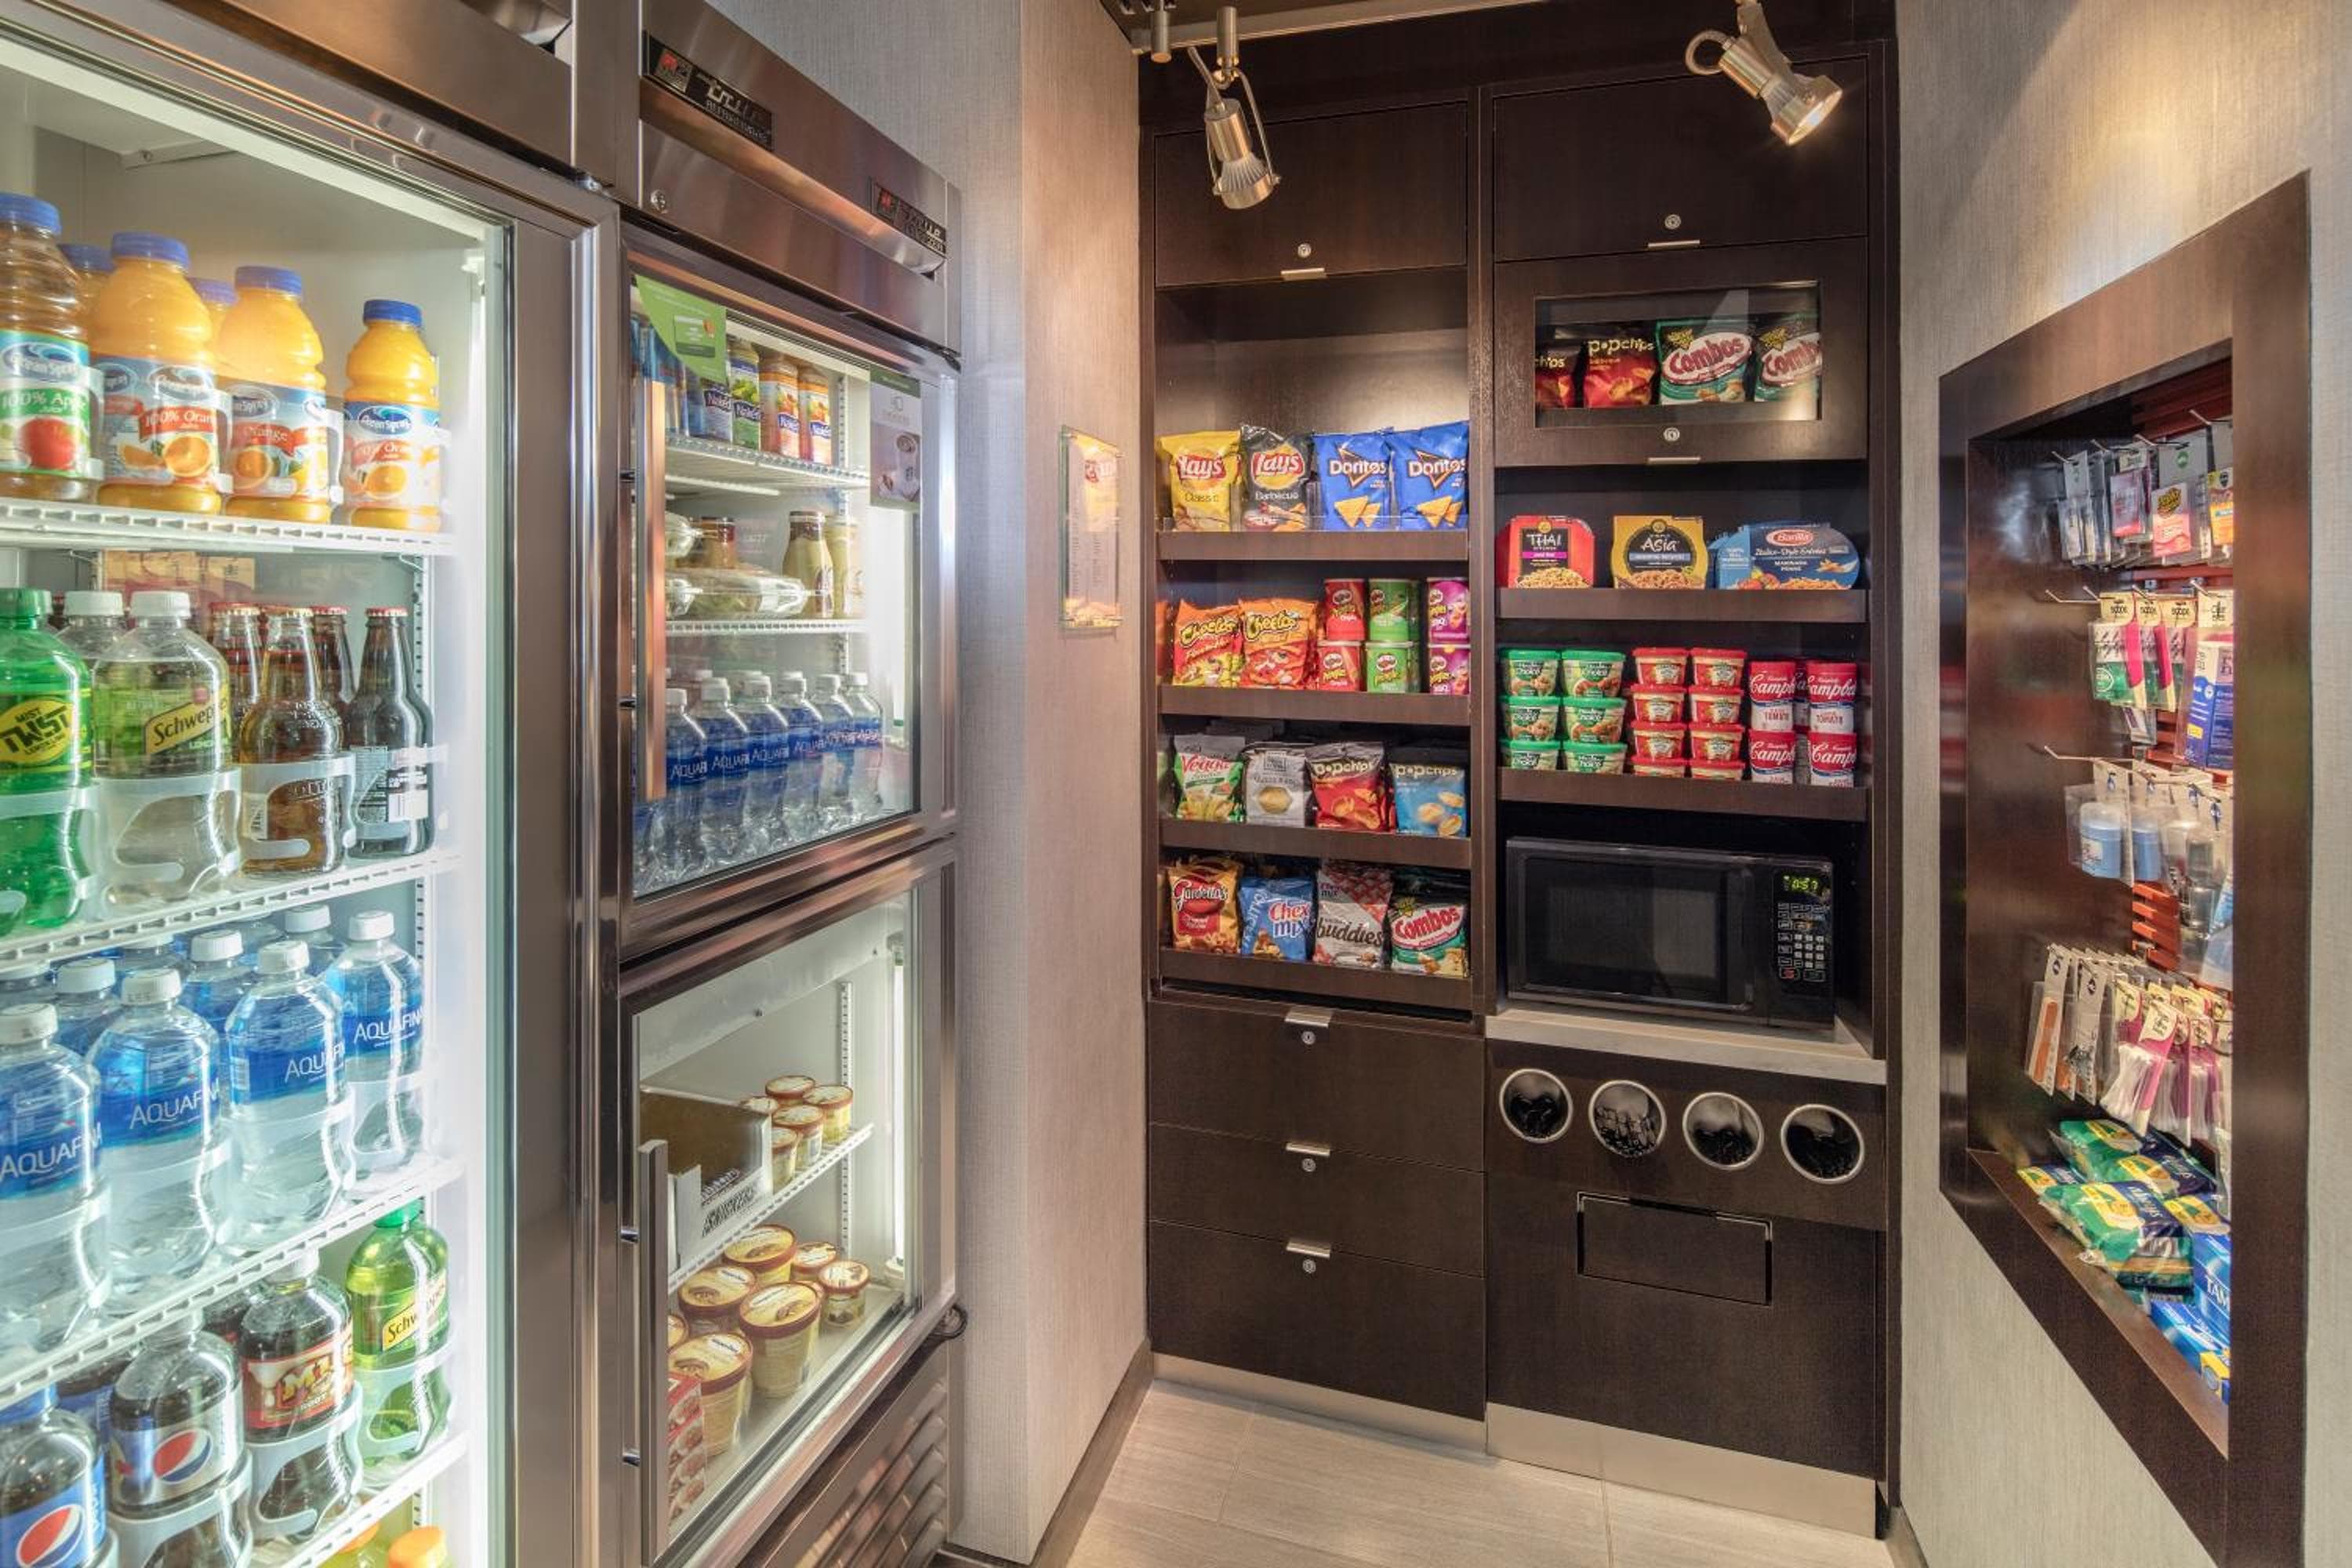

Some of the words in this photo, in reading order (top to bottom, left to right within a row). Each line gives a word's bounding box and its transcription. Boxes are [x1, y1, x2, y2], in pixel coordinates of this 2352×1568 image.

[1588, 339, 1655, 357] popchips
[1670, 337, 1744, 374] Combos
[1330, 459, 1386, 475] Doritos
[1526, 533, 1561, 546] THAI
[1641, 537, 1676, 552] Asia
[1247, 612, 1297, 640] Cheetos
[1396, 765, 1457, 778] popchips
[1269, 902, 1311, 922] Chex
[1317, 917, 1383, 946] buddies
[1395, 907, 1460, 942] Combos
